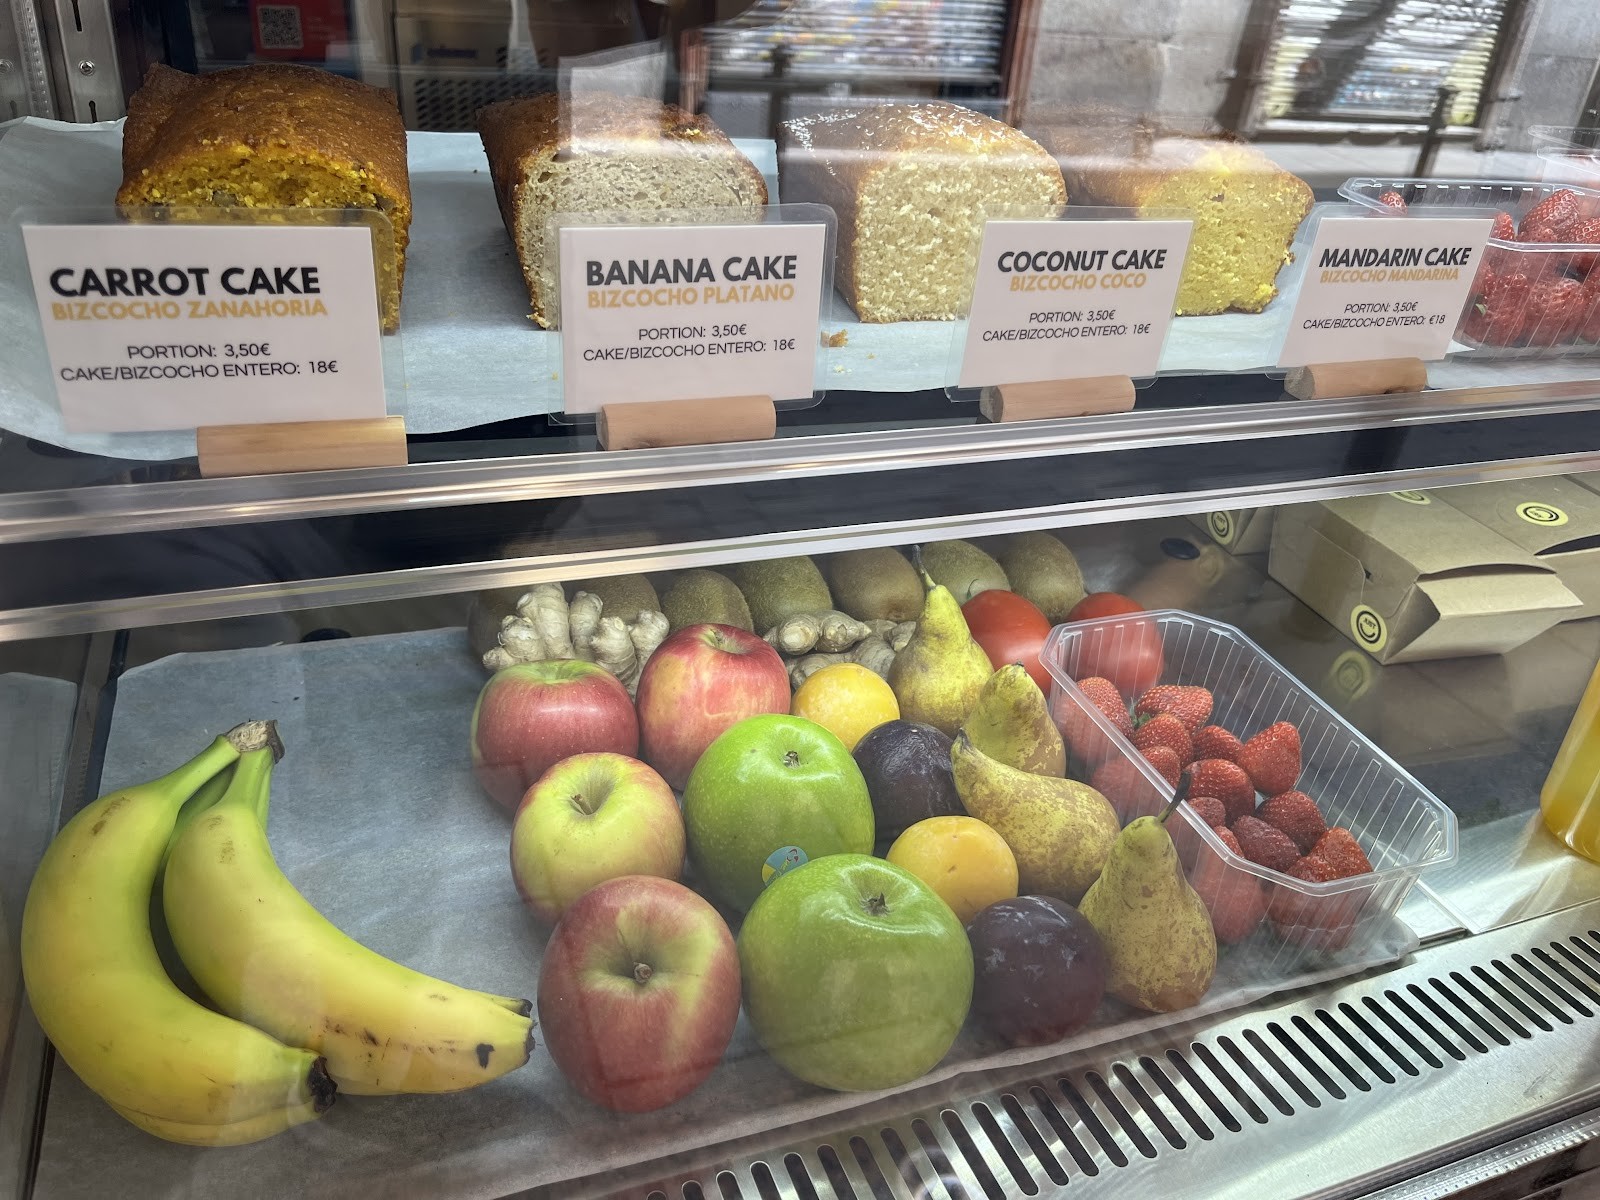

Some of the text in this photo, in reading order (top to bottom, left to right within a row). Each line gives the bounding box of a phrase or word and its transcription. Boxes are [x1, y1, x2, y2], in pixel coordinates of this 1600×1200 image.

[997, 249, 1168, 273] COCONUT CAKE
[1318, 247, 1473, 268] MANDARIN CAKE
[586, 255, 797, 286] BANANA CAKE
[1319, 267, 1460, 284] BIZCOCHO MANDARINA
[50, 266, 321, 297] CARROT CAKE
[1009, 272, 1147, 292] BIZCOCHO COCO
[587, 283, 795, 309] BIZCOCHO PLATANO
[52, 298, 328, 321] BIZCOCHO ZANAHORIA
[1029, 309, 1117, 324] PORTION: 3,50€
[1343, 301, 1419, 314] PORTION: 3,50€
[638, 323, 747, 341] PORTION: 3,50€
[1302, 314, 1446, 330] CAKE/BIZCOCHO ENTERO: €18
[982, 323, 1152, 342] CAKE/BIZCOCHO ENTERO: 18€
[127, 343, 271, 359] PORTION: 3,50€
[583, 338, 796, 361] CAKE/BIZCOCHO ENTERO: 18€
[60, 360, 338, 382] CAKE/BIZCOCHO ENTERO: 18€
[1362, 617, 1377, 630] JUST
